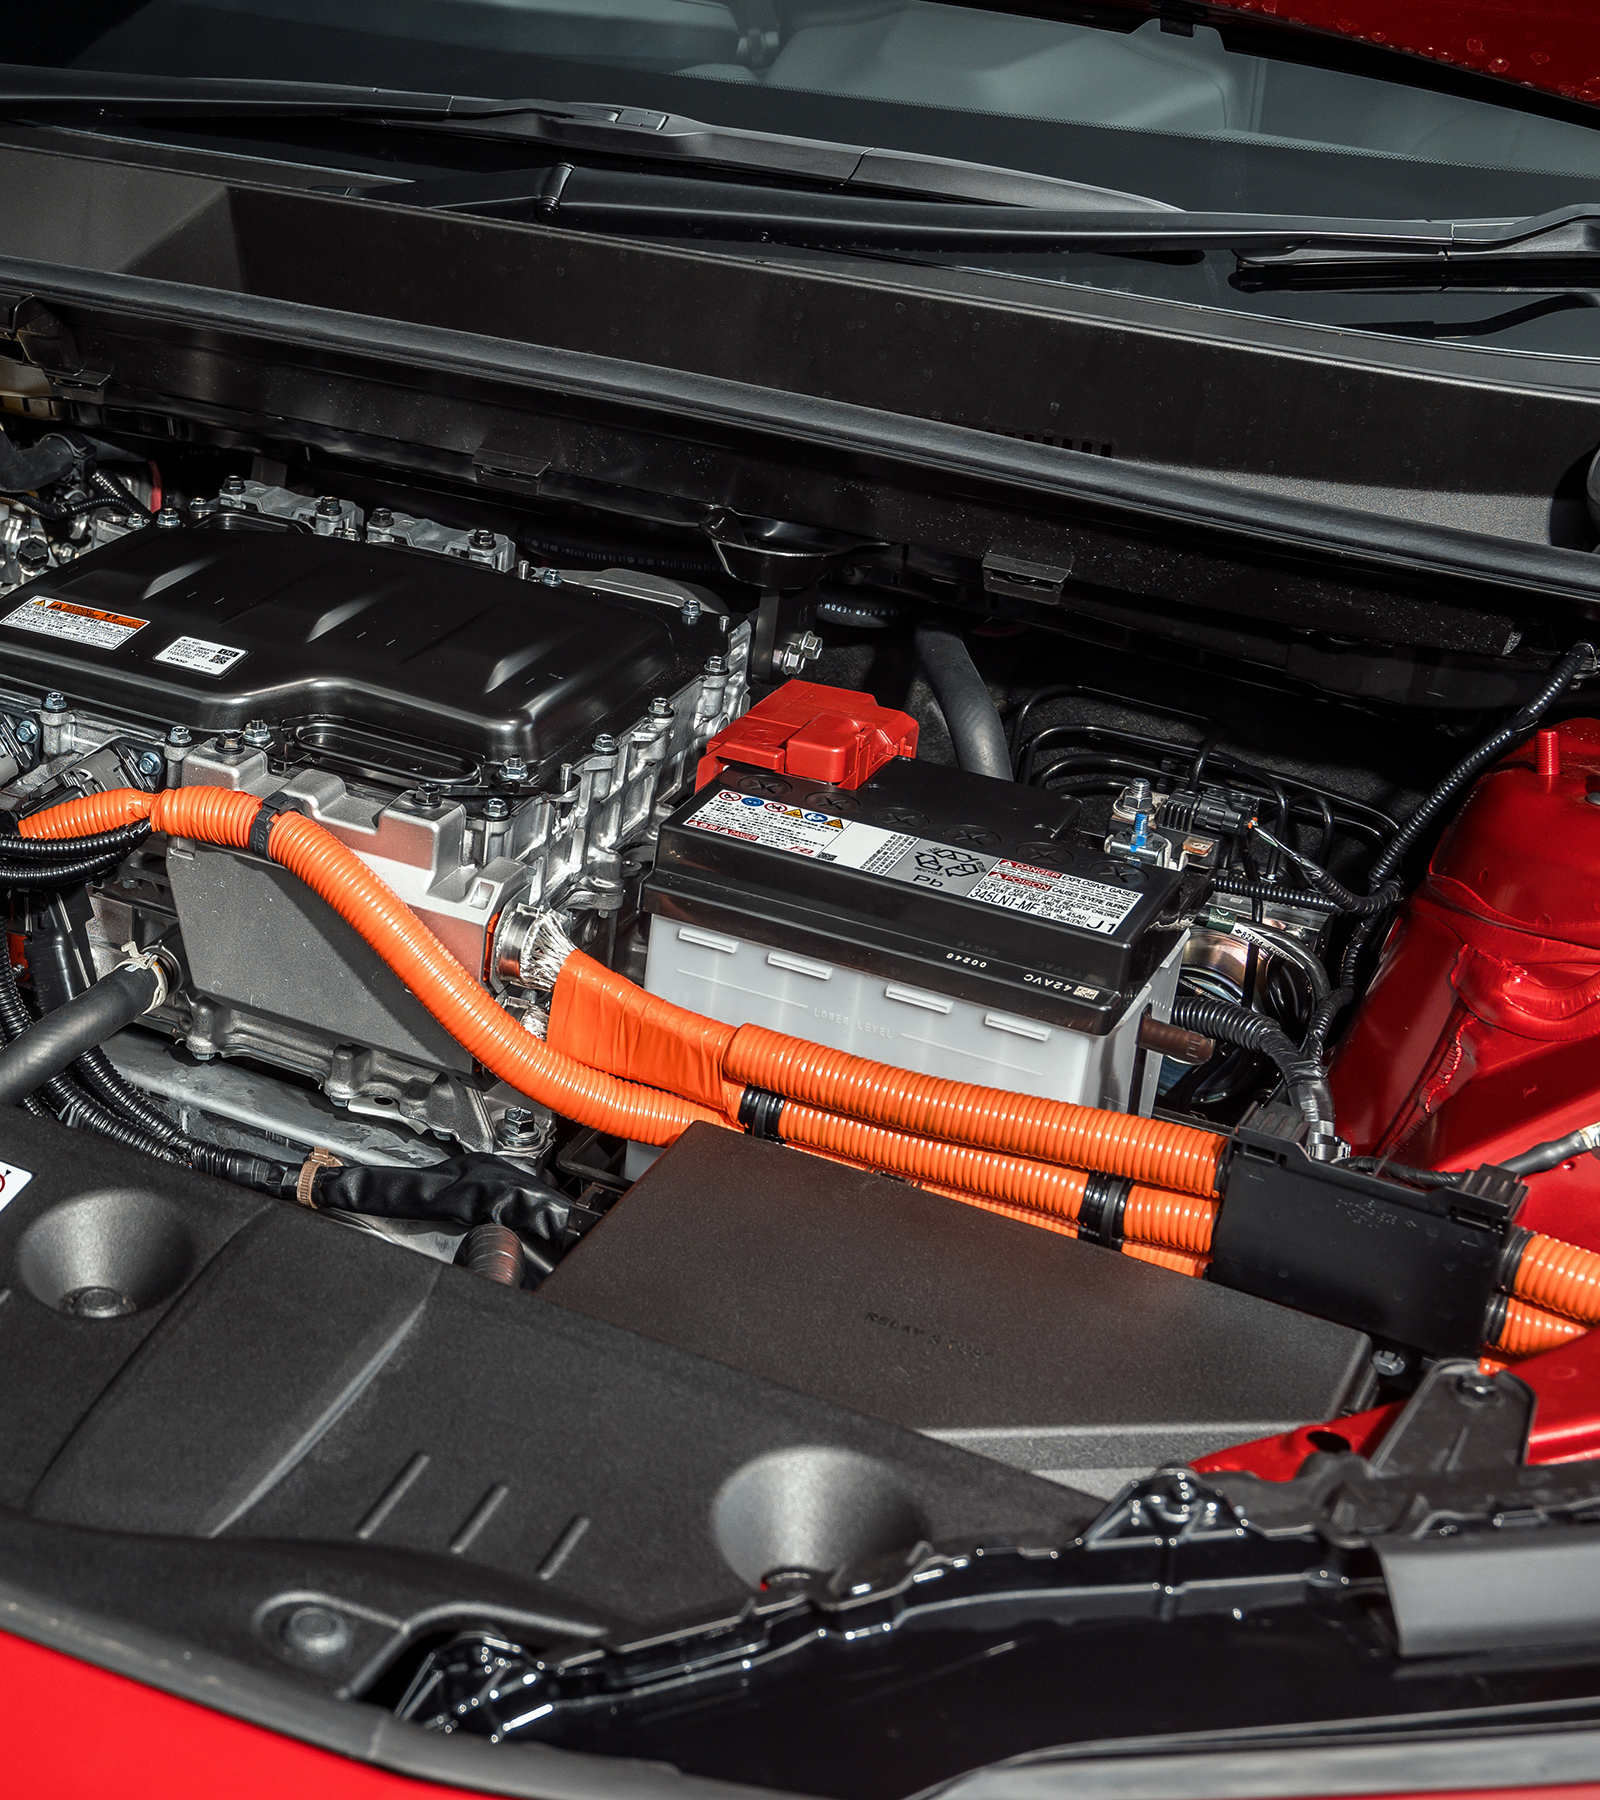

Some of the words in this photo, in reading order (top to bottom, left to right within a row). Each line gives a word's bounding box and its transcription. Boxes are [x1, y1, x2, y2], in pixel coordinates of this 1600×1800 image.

[729, 830, 758, 841] DANGER
[914, 866, 944, 877] RECYCLE
[913, 874, 943, 888] Pb
[1014, 862, 1061, 878] DANGER
[1061, 874, 1108, 890] EXPLOSIVE
[1108, 887, 1140, 898] GASES
[969, 887, 1040, 913] 345LN1-MF
[1003, 874, 1050, 890] POISON
[1050, 887, 1079, 898] CAUSES
[1078, 894, 1106, 905] SEVERE
[1104, 901, 1130, 911] BURNS
[1006, 890, 1024, 898] CAPS
[1023, 895, 1041, 903] TIGHT
[1040, 904, 1064, 914] 20HR
[1065, 911, 1087, 920] 45Ah
[1060, 900, 1082, 909] REACH
[1036, 909, 1053, 917] CCA
[1023, 973, 1073, 992] 42AVC
[813, 1007, 849, 1026] LOWER
[857, 1020, 893, 1039] LEVEL
